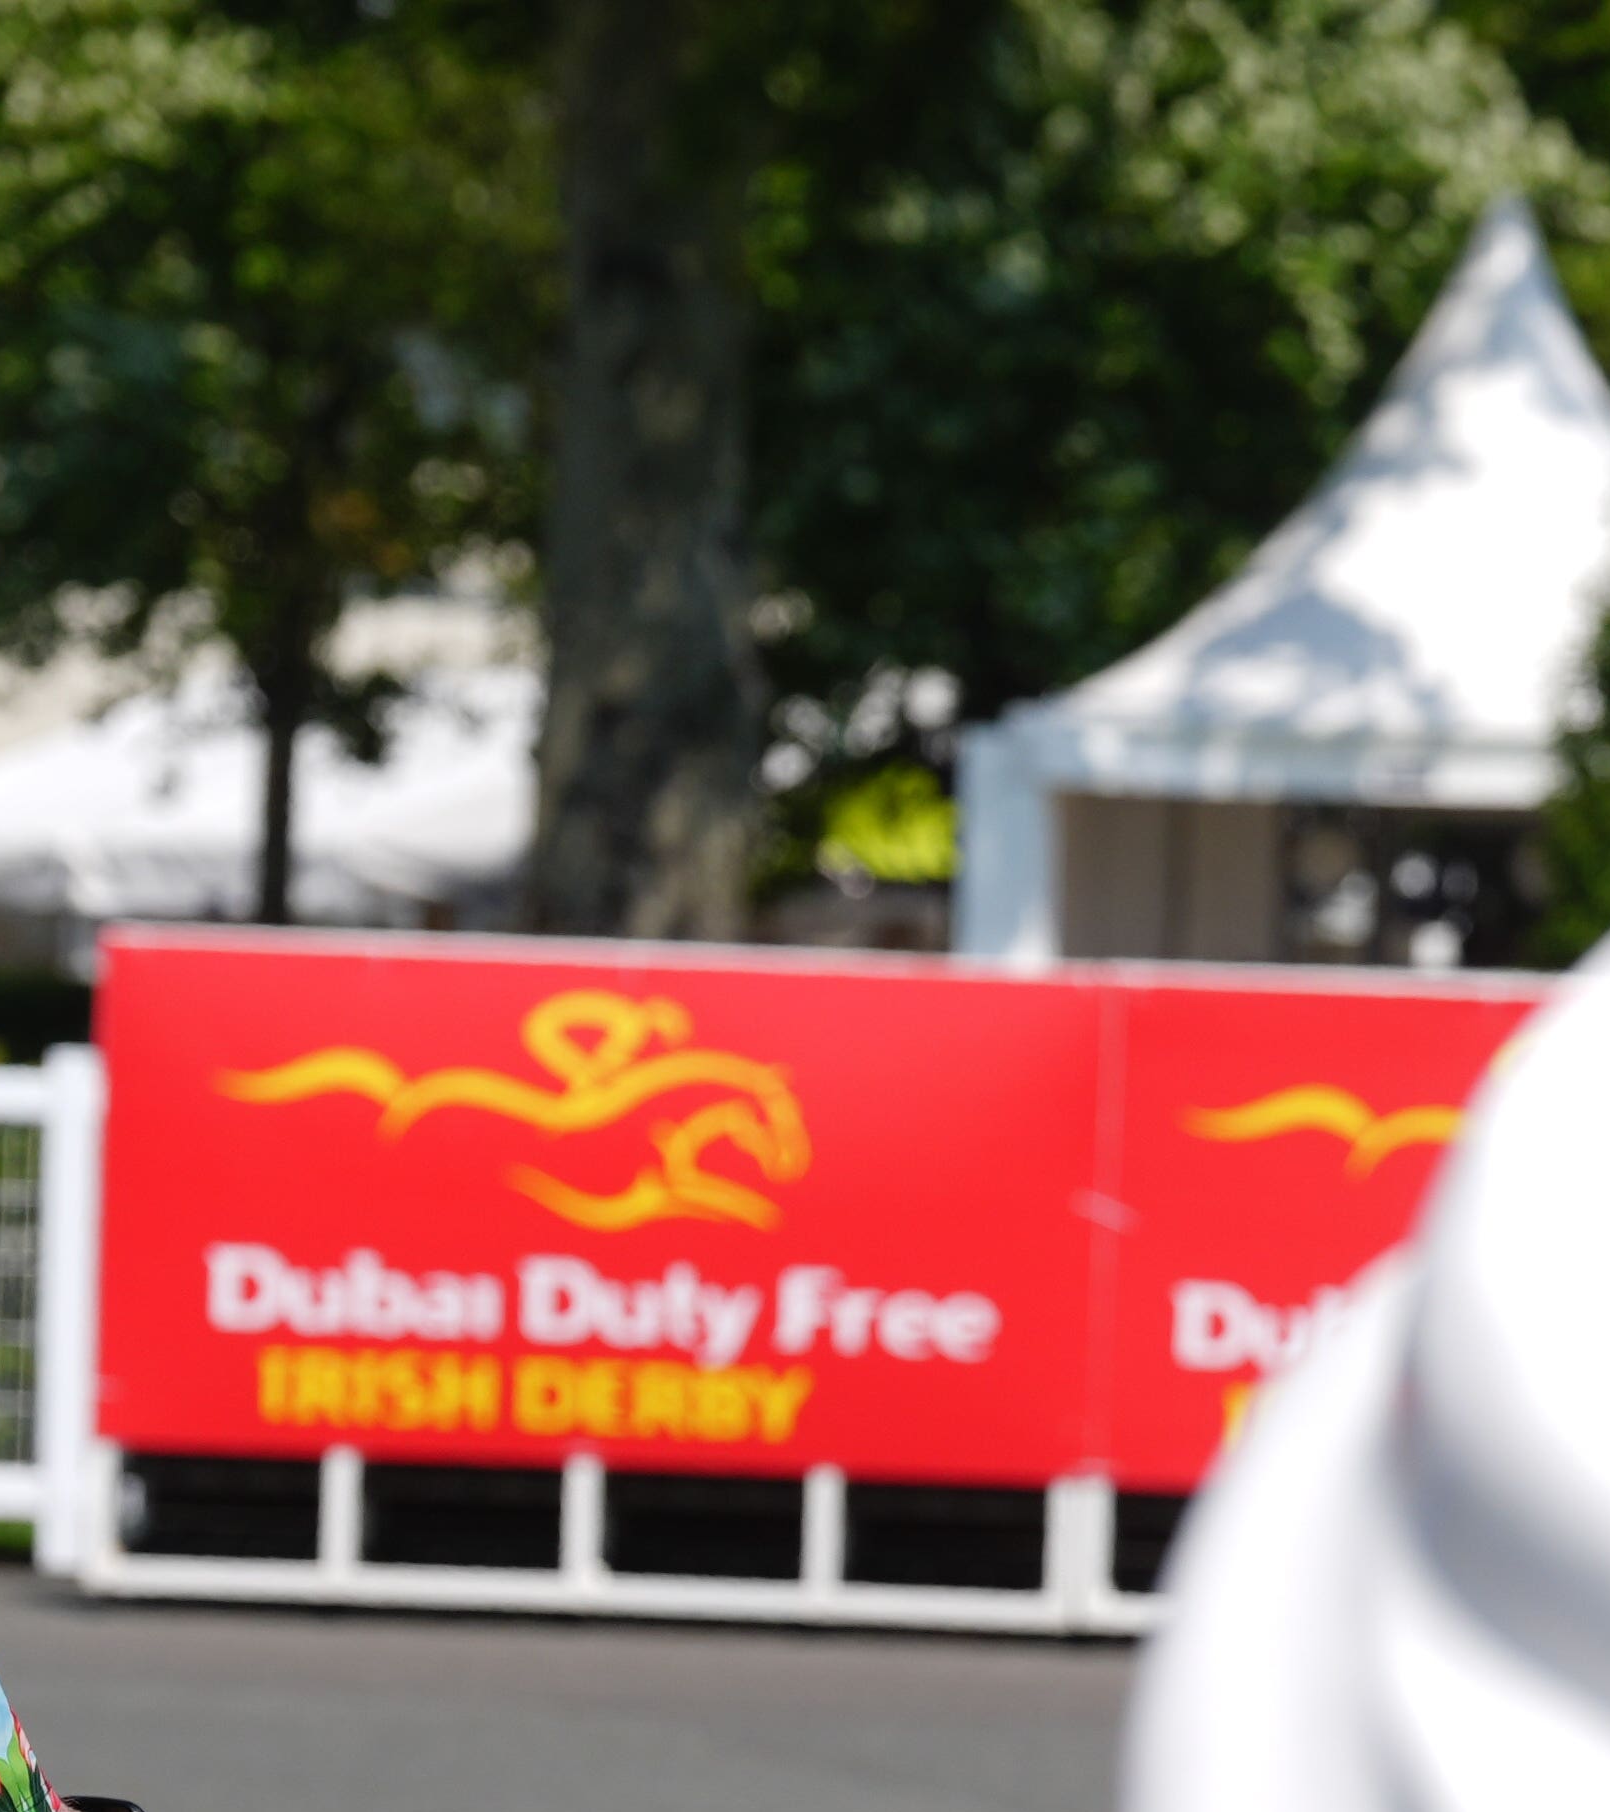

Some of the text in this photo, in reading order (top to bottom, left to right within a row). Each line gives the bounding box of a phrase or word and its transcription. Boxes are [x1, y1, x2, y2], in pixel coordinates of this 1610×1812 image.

[204, 1241, 1001, 1369] Dubai Duty Free
[258, 1344, 814, 1442] IRISH DERBY
